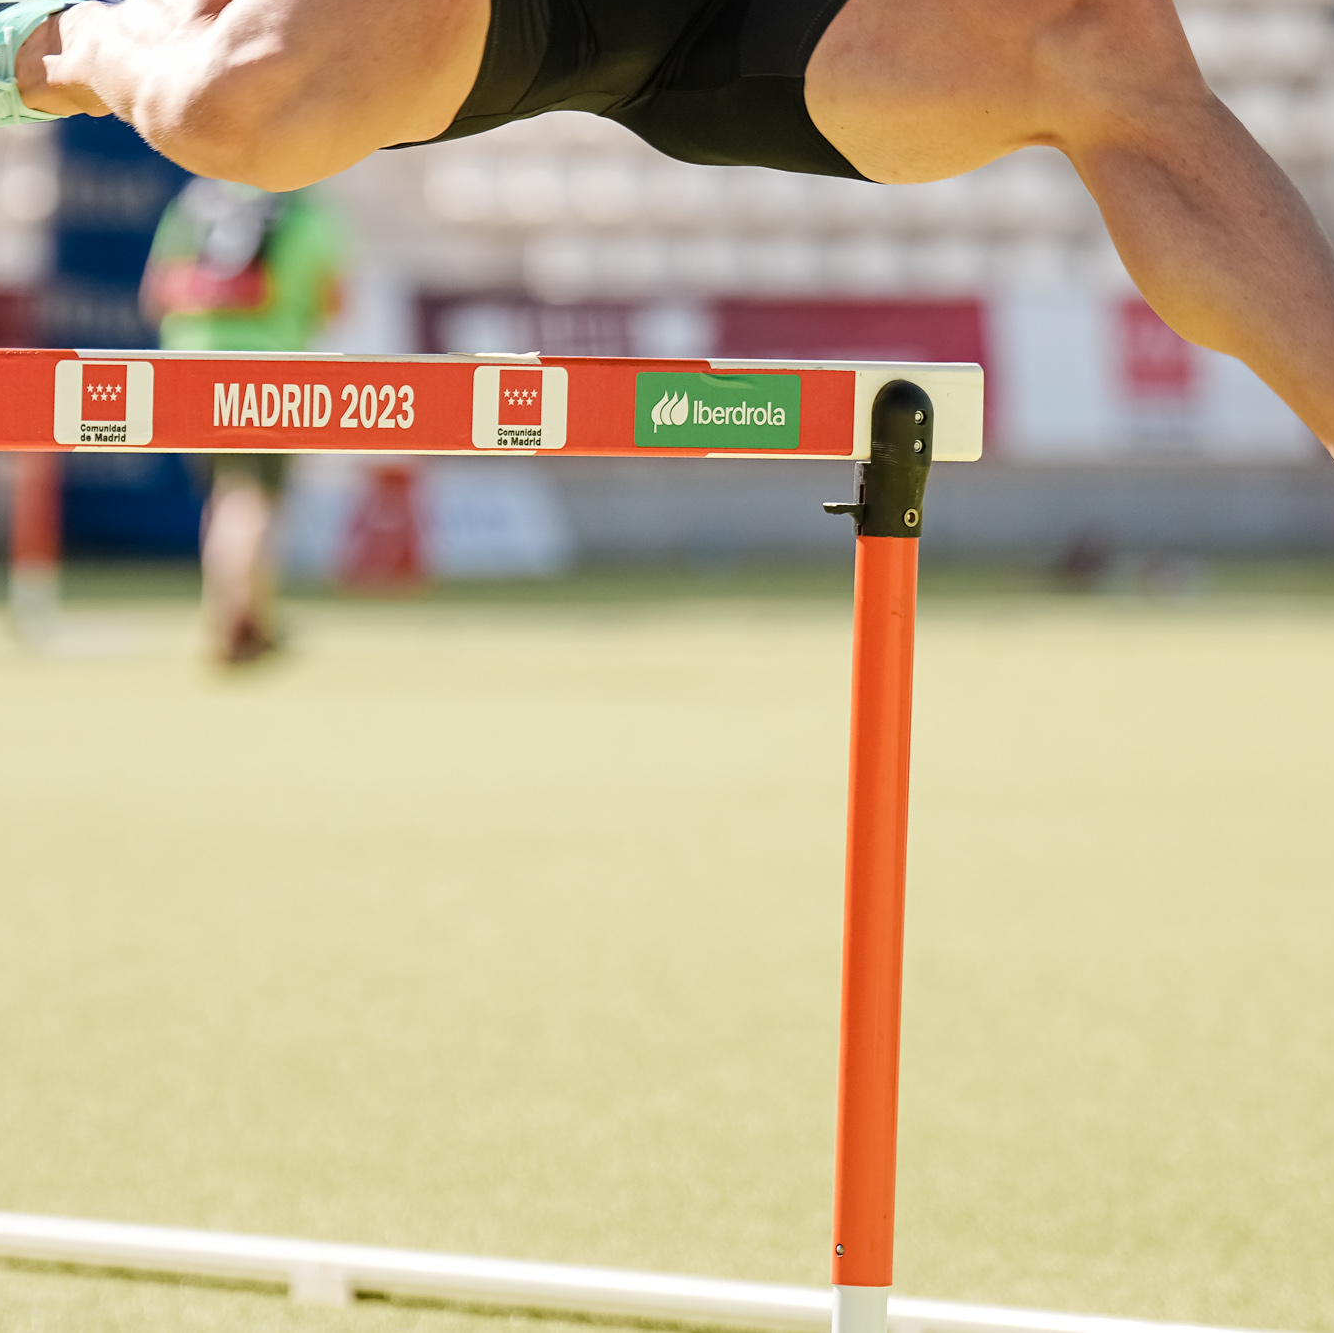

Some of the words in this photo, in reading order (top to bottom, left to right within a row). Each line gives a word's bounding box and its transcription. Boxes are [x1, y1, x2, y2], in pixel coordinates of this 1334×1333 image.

[213, 383, 332, 428] MADRID
[339, 384, 415, 429] 2023
[693, 400, 786, 426] Iberdrola
[80, 423, 127, 433] Comunidad
[497, 427, 542, 437] Comunidad
[80, 433, 92, 442] de
[94, 433, 127, 443] Madrid
[497, 436, 508, 446] de
[510, 436, 542, 446] Madrid
